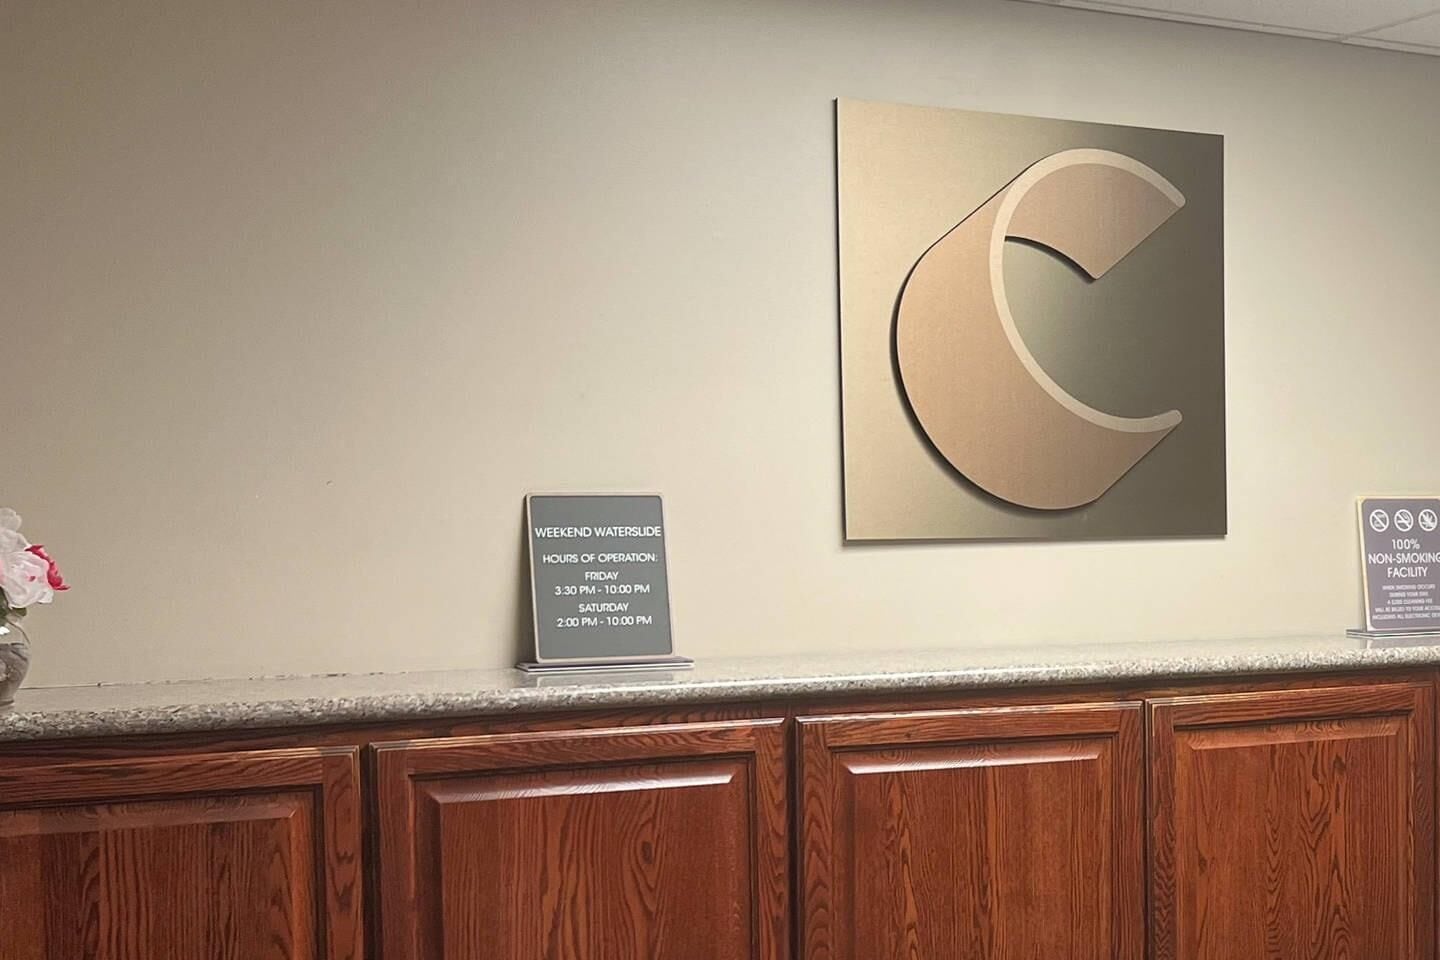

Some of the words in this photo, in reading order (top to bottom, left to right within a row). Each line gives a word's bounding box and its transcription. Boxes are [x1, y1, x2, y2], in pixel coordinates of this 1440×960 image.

[535, 527, 592, 538] WEEKEND
[594, 526, 662, 538] WATERSLIDE
[1391, 538, 1420, 550] 100%
[543, 554, 578, 564] HOURS
[581, 553, 596, 563] OF
[598, 553, 658, 563] OPERATION:
[585, 572, 619, 581] FRIDAY
[1387, 567, 1428, 578] FACILITY
[554, 586, 577, 596] 3:30
[579, 585, 596, 595] PM
[604, 585, 632, 594] 10:00
[634, 584, 650, 593] PM
[579, 603, 629, 613] SATURDAY
[557, 618, 579, 628] 2:00
[581, 617, 597, 627] PM
[606, 616, 634, 626] 10:00
[636, 615, 652, 625] PM
